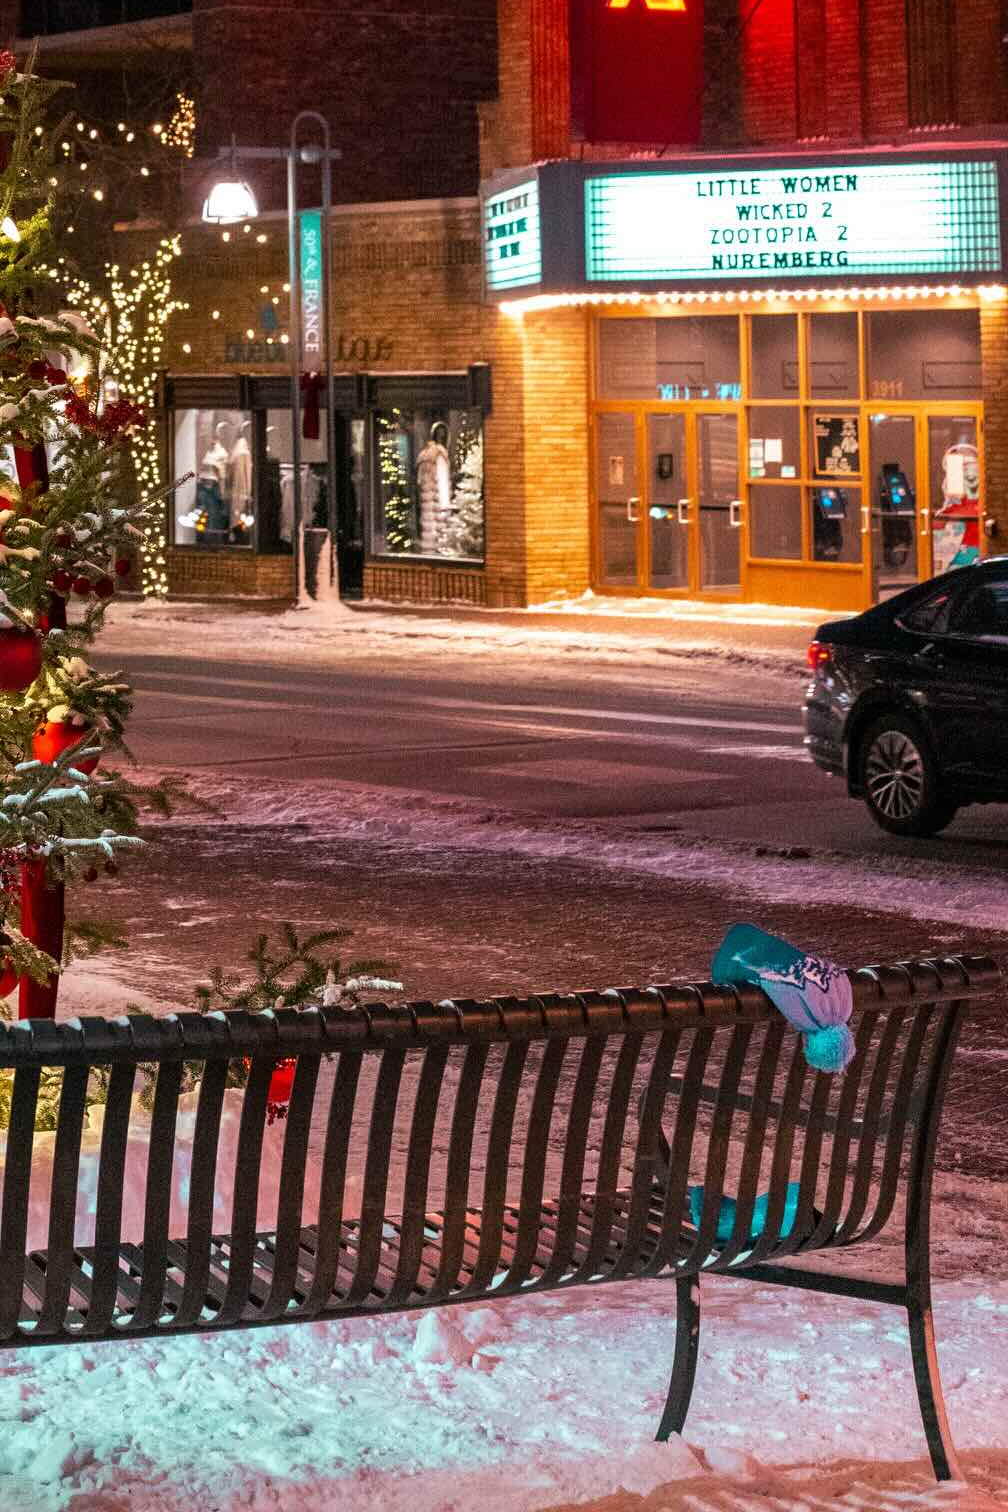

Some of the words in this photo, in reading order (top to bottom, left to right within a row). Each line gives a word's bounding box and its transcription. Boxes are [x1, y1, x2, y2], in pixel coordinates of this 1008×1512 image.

[696, 178, 761, 196] LITTLE
[781, 174, 858, 193] WOMEN
[736, 202, 808, 220] WICKED
[821, 201, 833, 218] 2
[709, 226, 818, 245] ZOOTOPIA
[837, 225, 848, 241] 2
[711, 251, 849, 270] NUREMBERG
[304, 279, 319, 353] FRANCE
